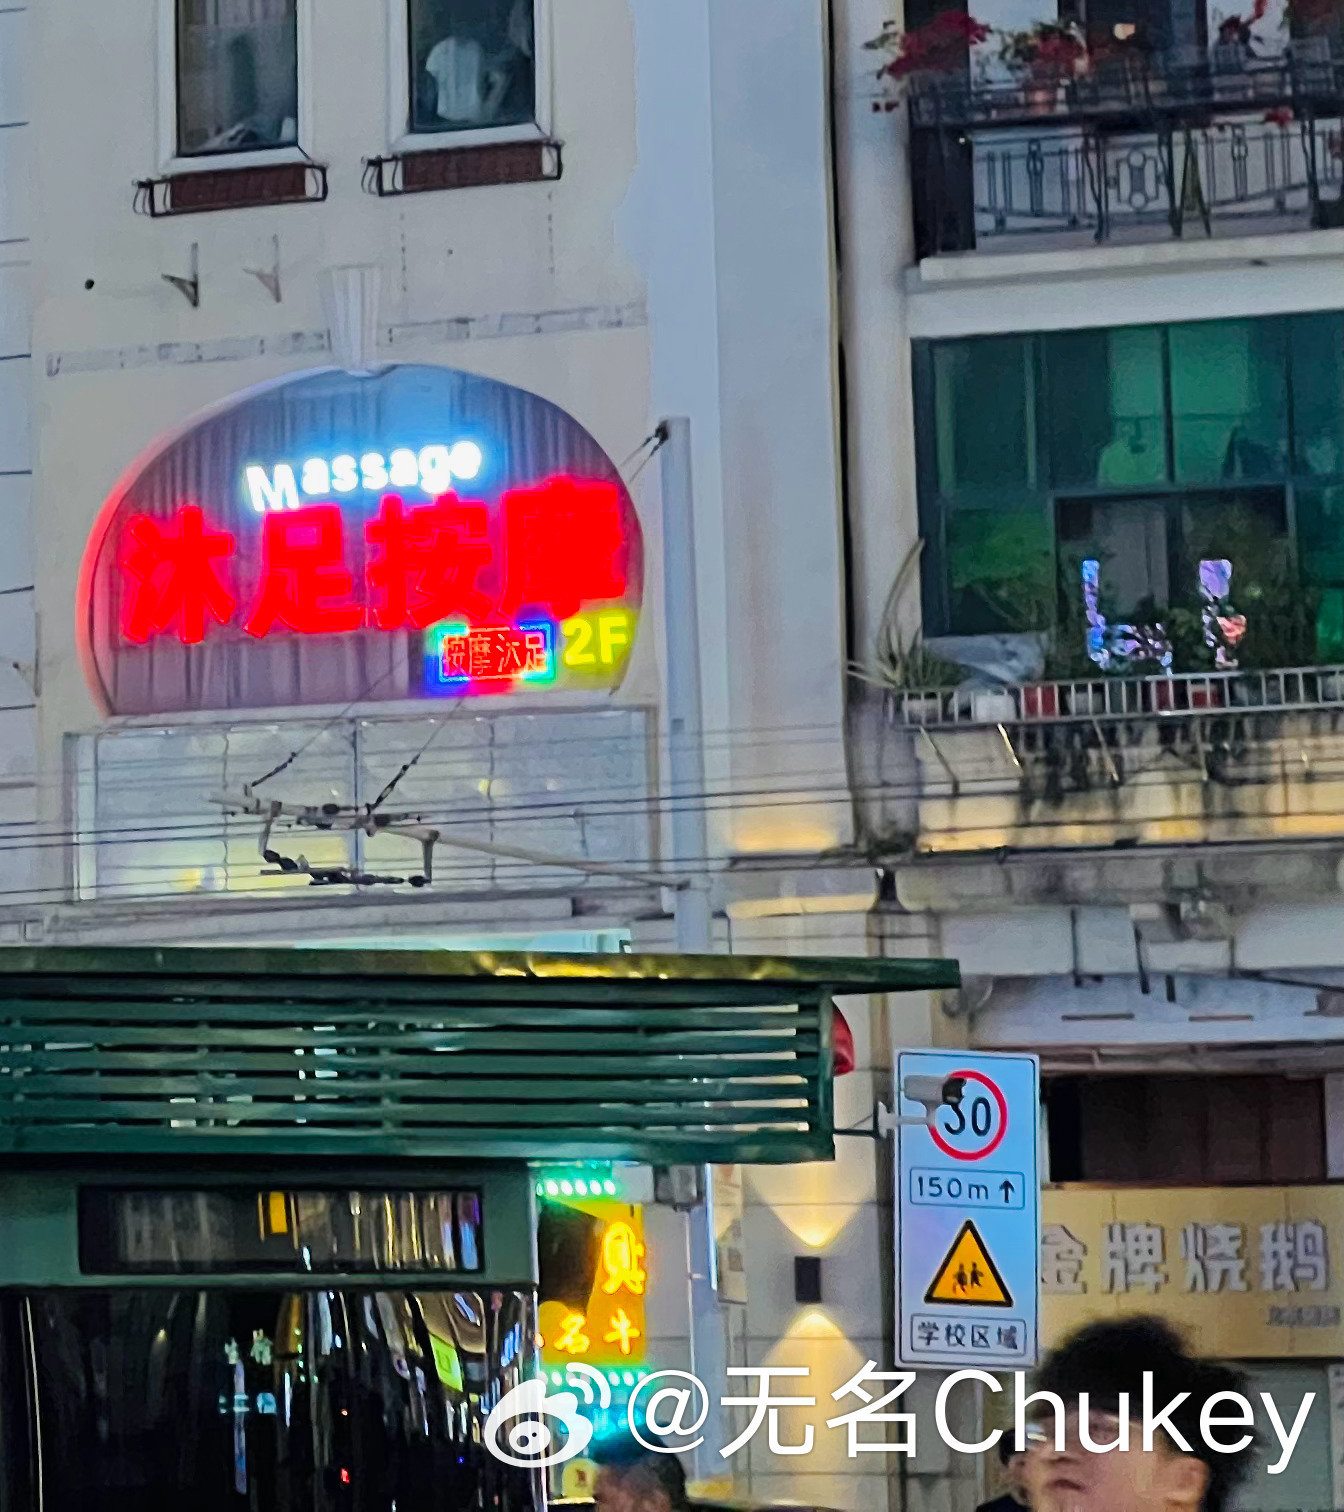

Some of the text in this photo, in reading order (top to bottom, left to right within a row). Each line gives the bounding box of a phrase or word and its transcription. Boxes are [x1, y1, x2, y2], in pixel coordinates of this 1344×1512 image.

[244, 439, 483, 513] Massage
[120, 474, 628, 645] 沐足按摩
[440, 631, 550, 678] 按摩沐足
[563, 615, 630, 668] 2F
[917, 1175, 990, 1201] 150m
[1040, 1220, 1330, 1294] 金牌烧鹅
[917, 1321, 1019, 1350] 学校区域
